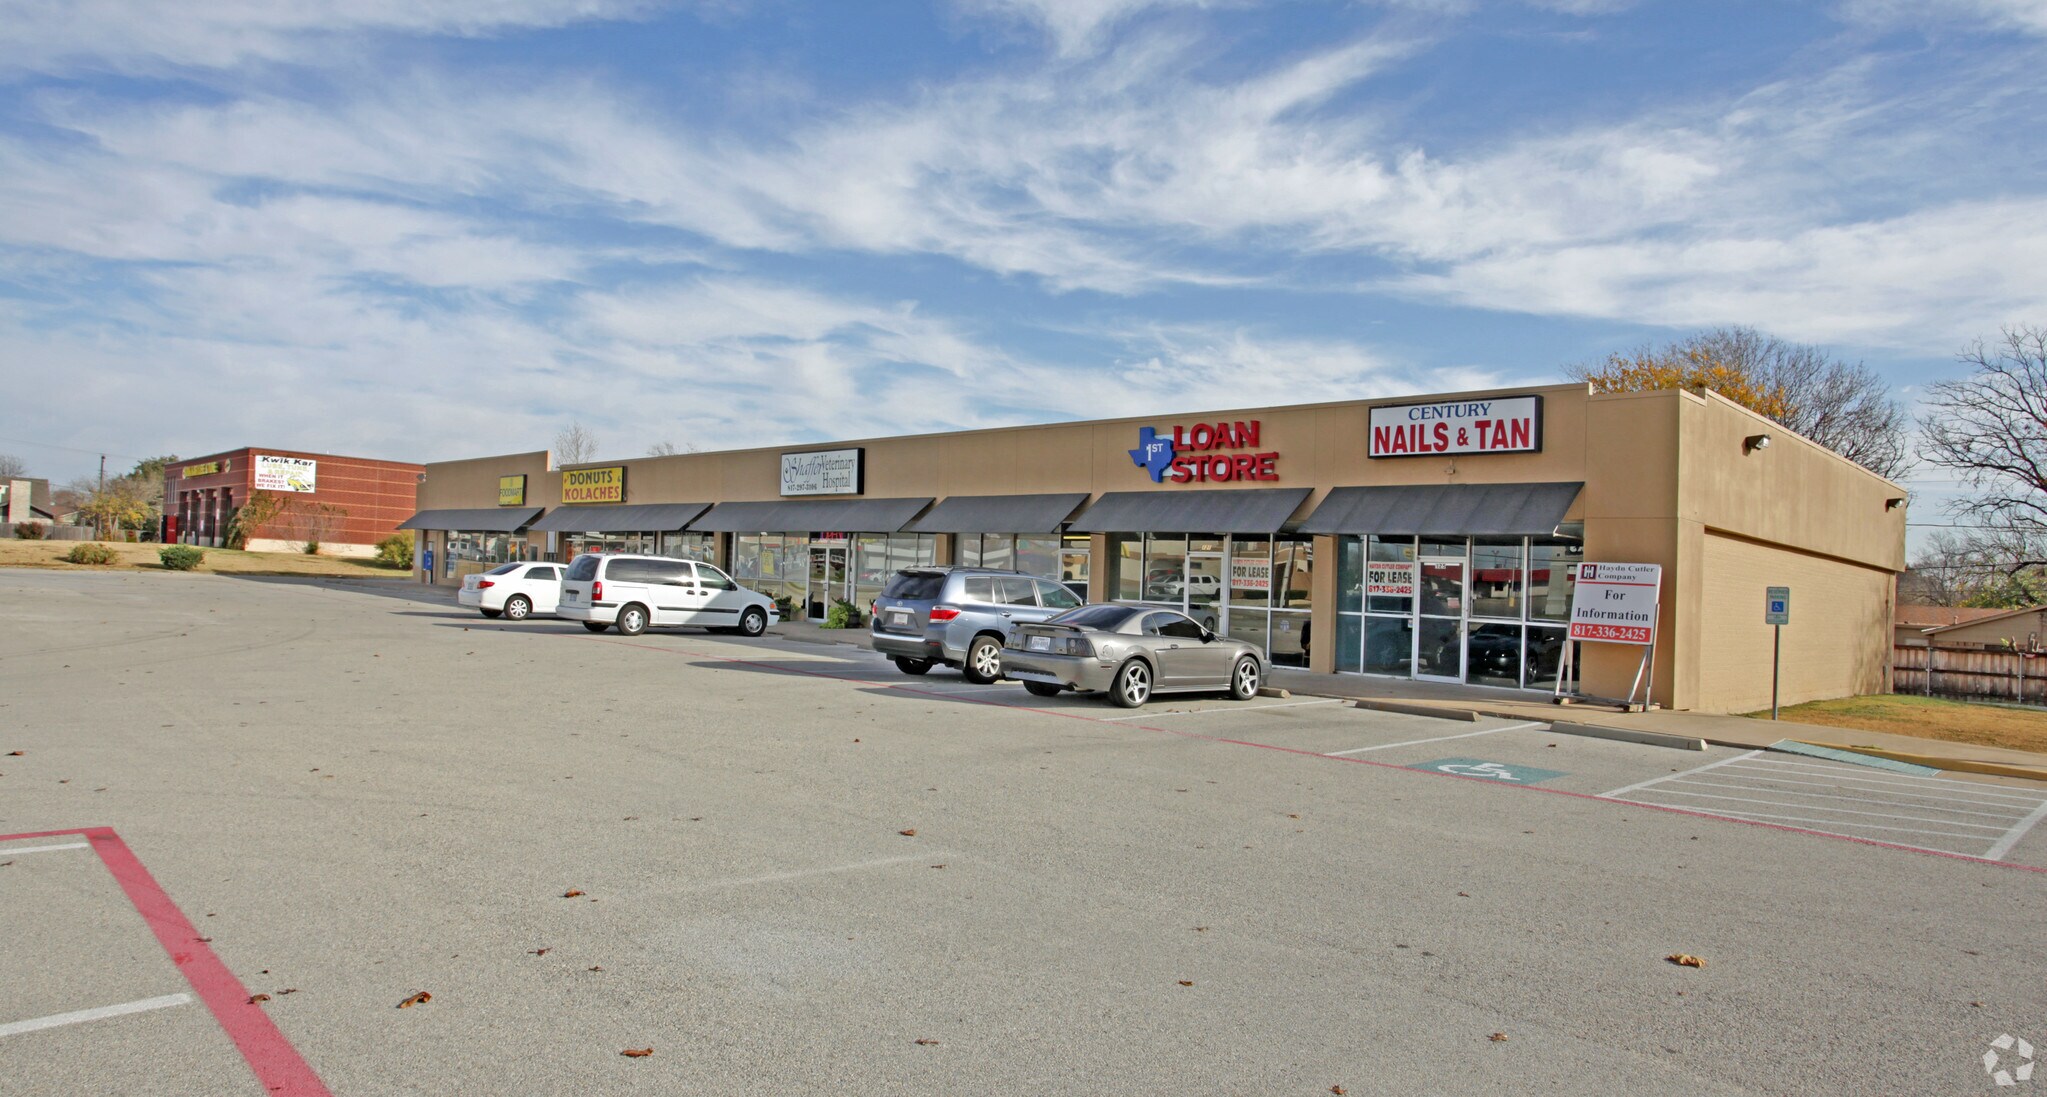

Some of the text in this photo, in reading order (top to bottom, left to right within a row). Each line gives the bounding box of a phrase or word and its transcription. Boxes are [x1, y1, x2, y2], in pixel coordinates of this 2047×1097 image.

[1408, 402, 1492, 420] CENTURY
[1146, 420, 1261, 461] 1ST LOAN
[1374, 418, 1530, 454] NAILS & TAN
[262, 456, 289, 464] Kwik
[1170, 452, 1279, 483] STORE
[570, 470, 614, 486] DONUTS
[822, 471, 850, 492] Hospital
[564, 486, 620, 501] KOLACHES
[1232, 566, 1269, 578] FOR LEASE
[1599, 564, 1626, 572] Haydn
[1628, 565, 1654, 573] Cutler
[1369, 570, 1412, 584] FOR LEASE
[1598, 572, 1637, 581] Company
[1604, 589, 1626, 600] For
[1577, 607, 1649, 621] Information
[1574, 624, 1646, 640] 817-336-2425
